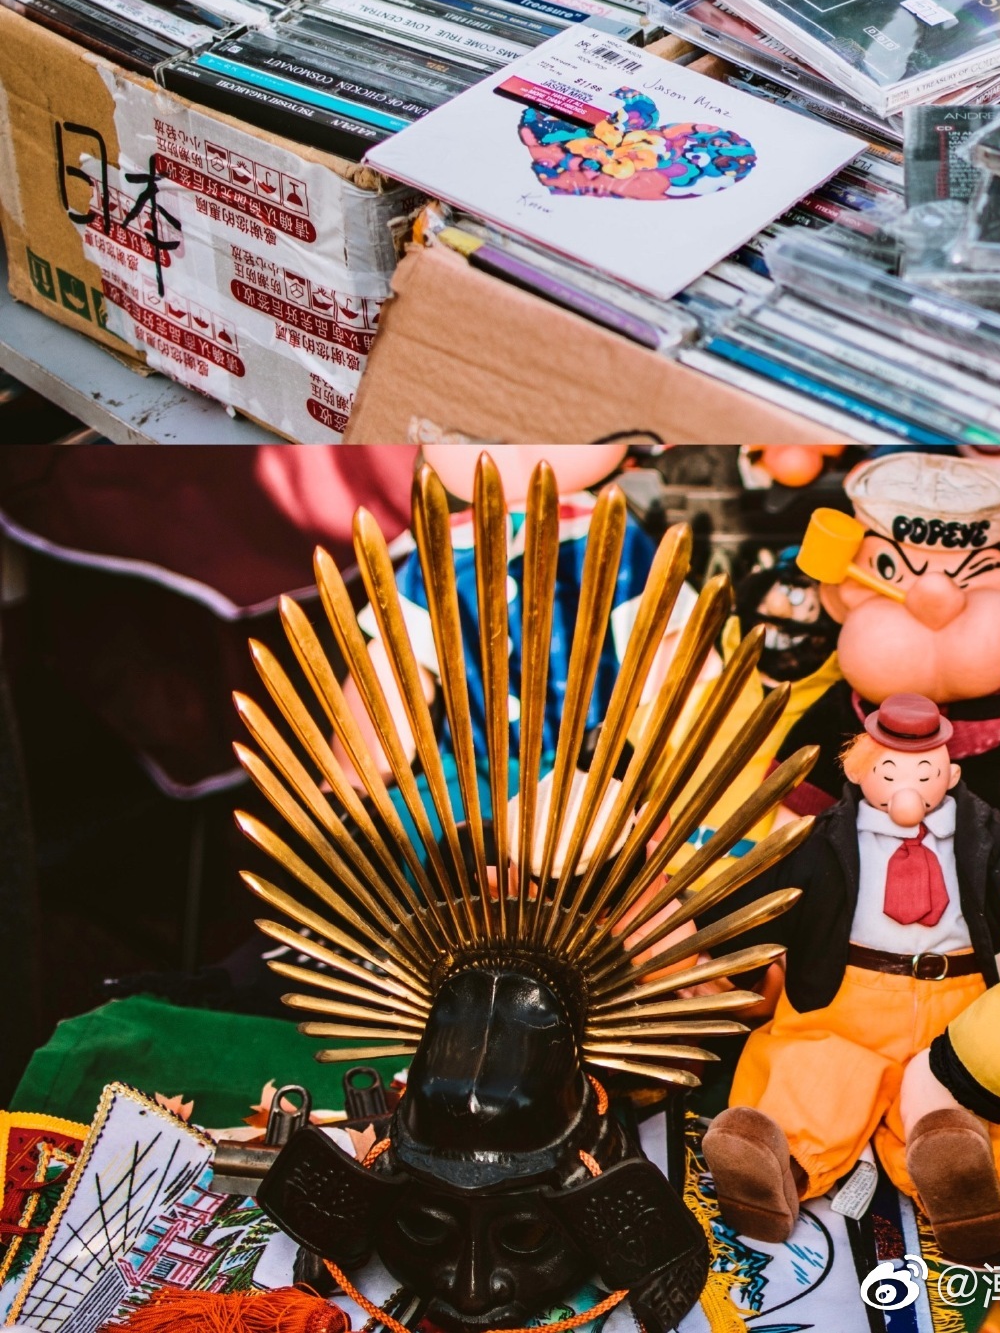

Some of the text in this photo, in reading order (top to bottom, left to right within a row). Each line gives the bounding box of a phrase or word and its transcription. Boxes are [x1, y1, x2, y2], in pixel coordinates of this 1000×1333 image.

[264, 56, 334, 86] COSMONAUT
[922, 72, 958, 92] TREASURY
[216, 78, 269, 104] NAGABUCHI
[335, 78, 384, 105] CHICKEN
[540, 80, 593, 104] JASON MRAZ
[642, 77, 734, 120] Jason Mraz
[154, 135, 205, 167] 防潮防压
[55, 119, 183, 298] 日本
[195, 194, 279, 246] 感谢您的惠顾
[234, 260, 282, 295] 防潮防压
[274, 320, 361, 372] 感谢您的惠顾
[893, 513, 991, 548] POPEYE
